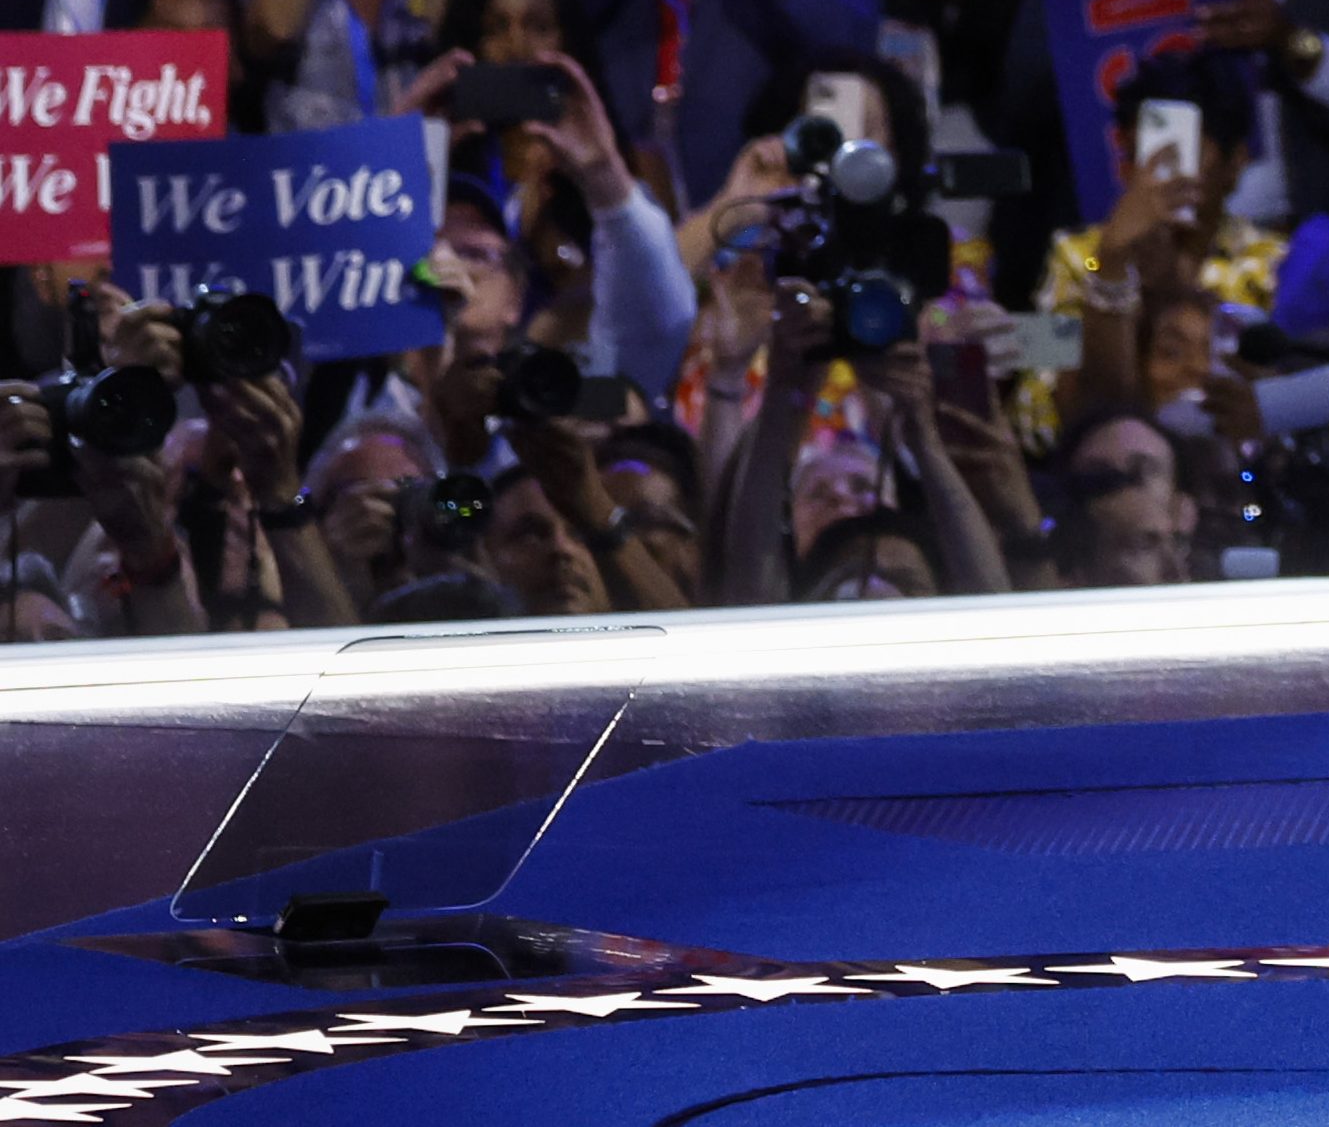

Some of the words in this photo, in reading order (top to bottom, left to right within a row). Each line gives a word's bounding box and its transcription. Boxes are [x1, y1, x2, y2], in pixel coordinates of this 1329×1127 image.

[74, 63, 211, 141] Fight,
[137, 173, 246, 234] We
[273, 164, 413, 228] Vote,
